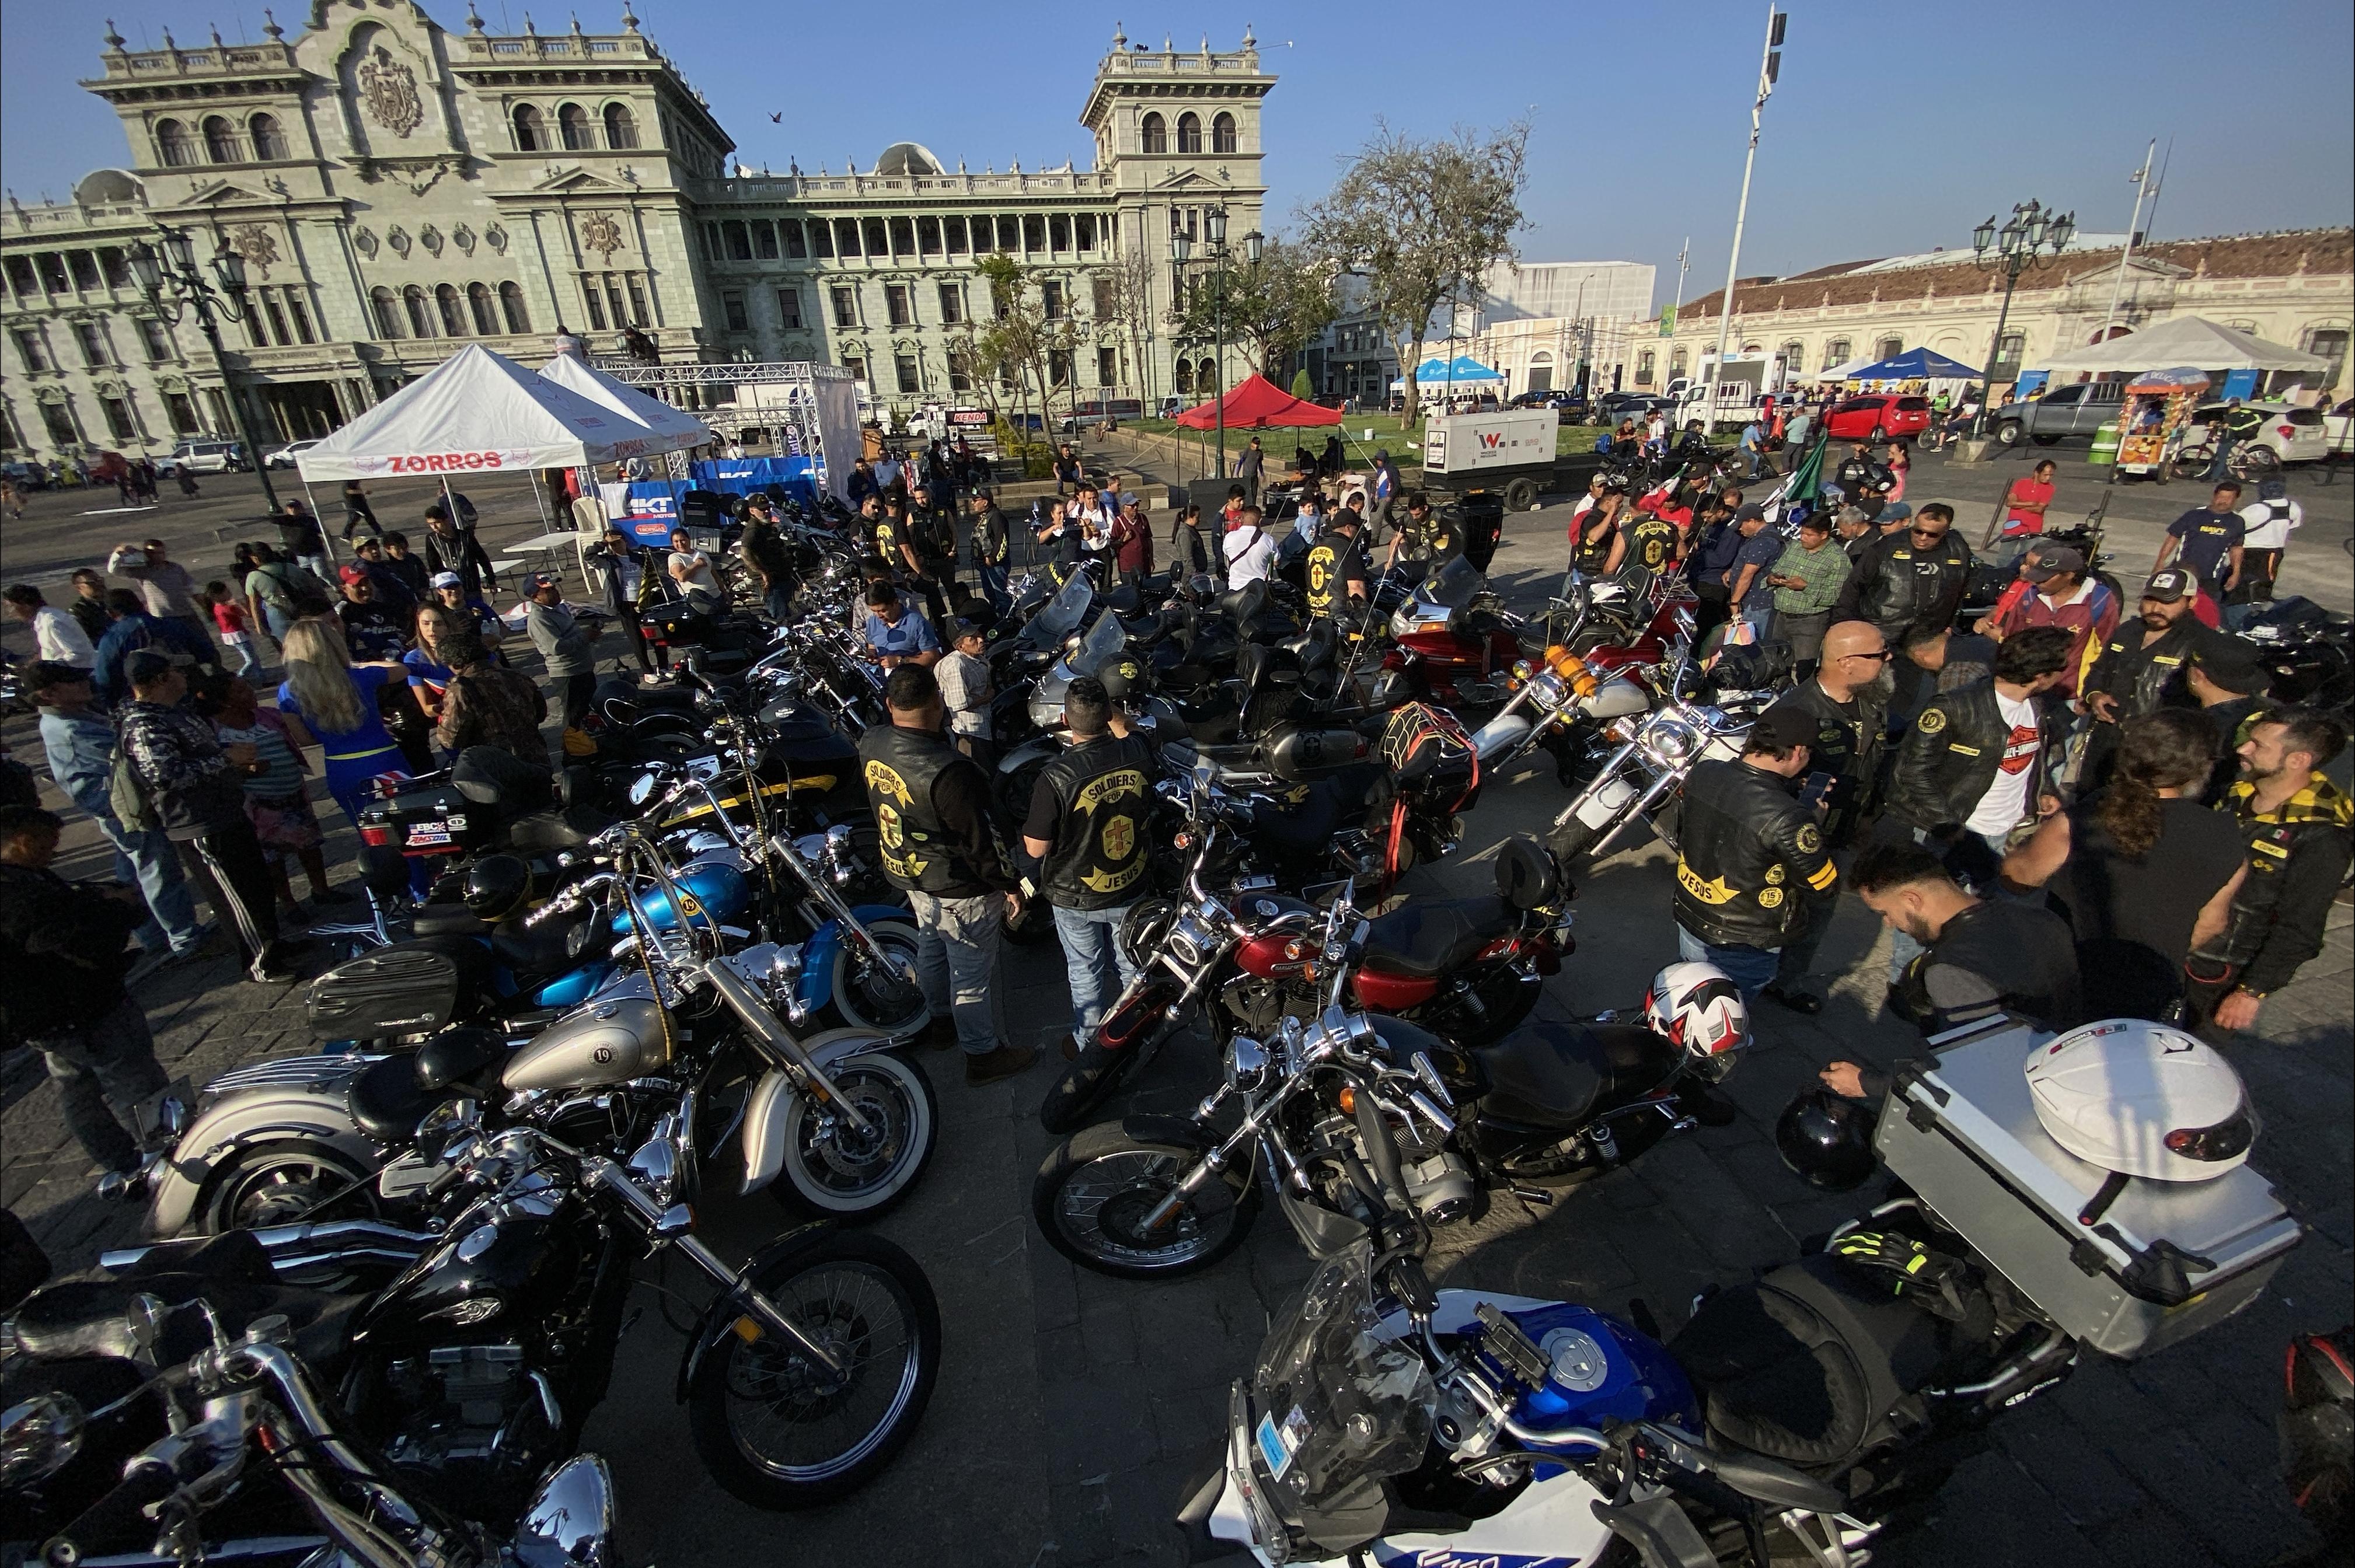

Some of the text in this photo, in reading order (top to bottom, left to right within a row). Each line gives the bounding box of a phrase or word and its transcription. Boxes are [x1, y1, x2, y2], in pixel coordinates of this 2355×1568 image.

[955, 413, 986, 421] KENDA
[388, 452, 502, 473] ZORROS
[1924, 714, 1938, 728] 19
[870, 765, 901, 791] SOLDIERS
[879, 782, 891, 792] FOR
[1088, 774, 1136, 800] SOLDIERS
[1107, 791, 1121, 802] FOR
[416, 822, 438, 831] EBC
[1104, 865, 1138, 889] JESUS
[1681, 872, 1712, 899] JESUS
[684, 900, 695, 910] 19
[597, 1049, 609, 1061] 19
